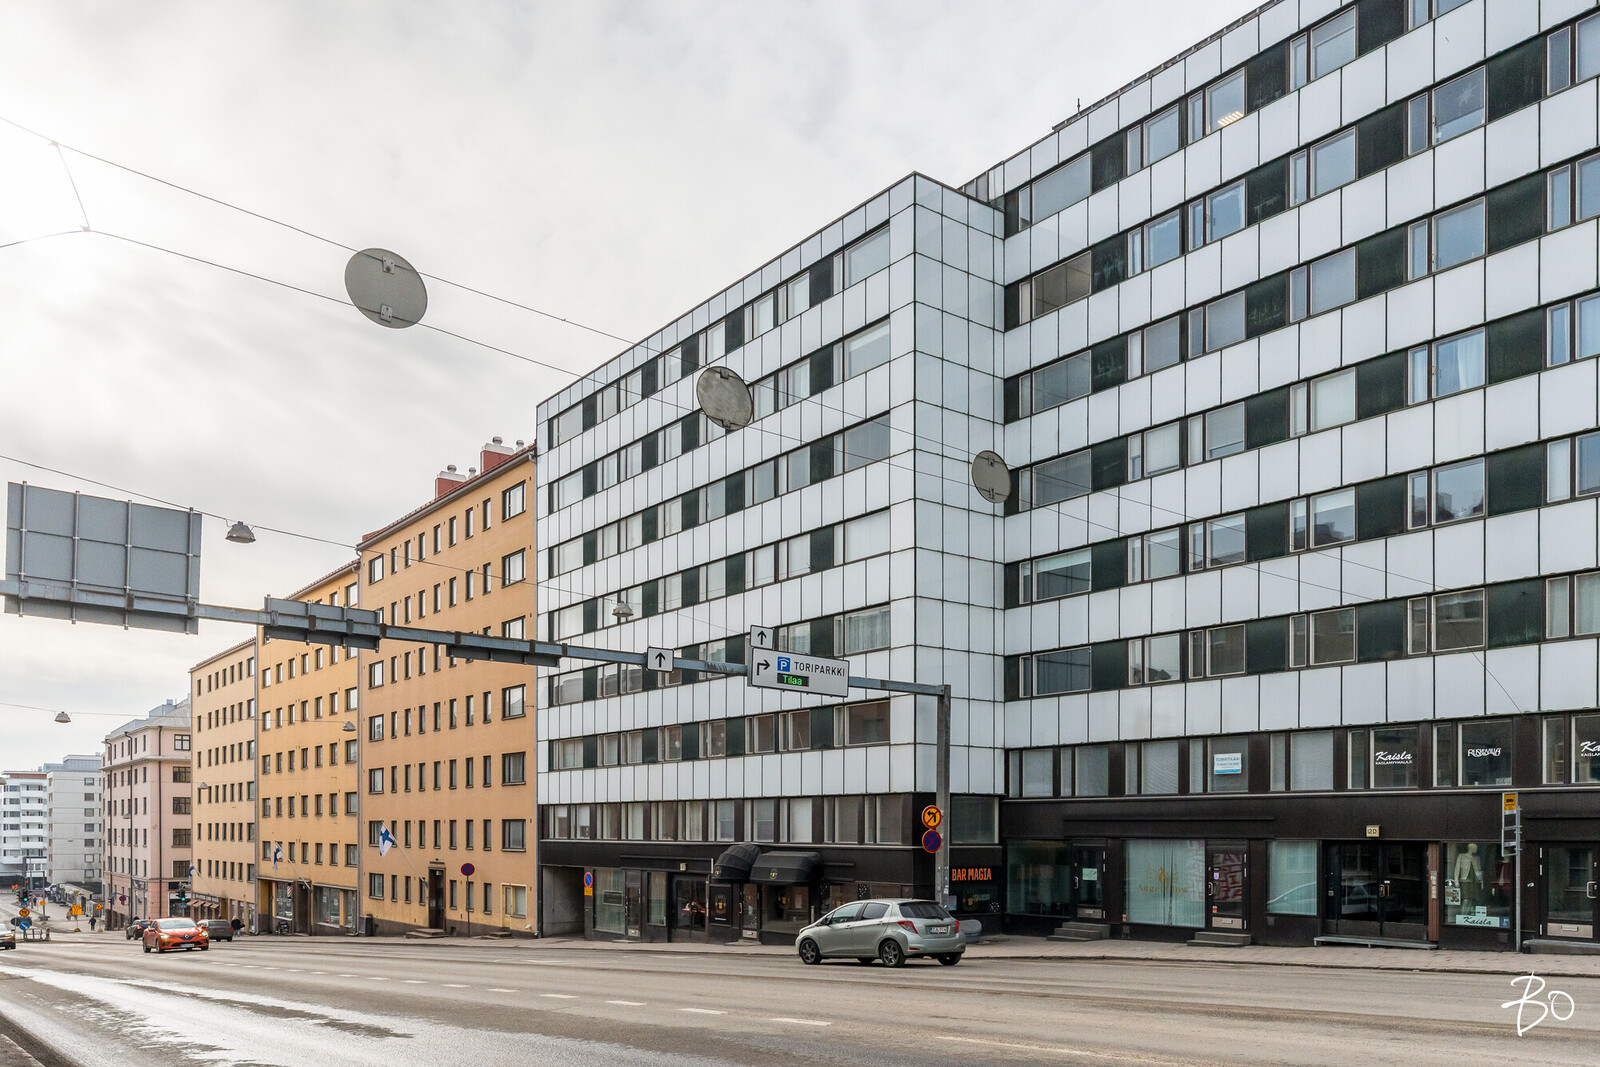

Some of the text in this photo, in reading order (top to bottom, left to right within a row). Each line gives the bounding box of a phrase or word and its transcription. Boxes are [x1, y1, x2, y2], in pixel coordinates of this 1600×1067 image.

[794, 661, 845, 677] TORIPARKKI
[783, 675, 803, 686] Tilaa
[1375, 750, 1413, 761] Kaisla
[951, 867, 992, 881] BAR MAGIA
[1463, 916, 1492, 926] Kaisla
